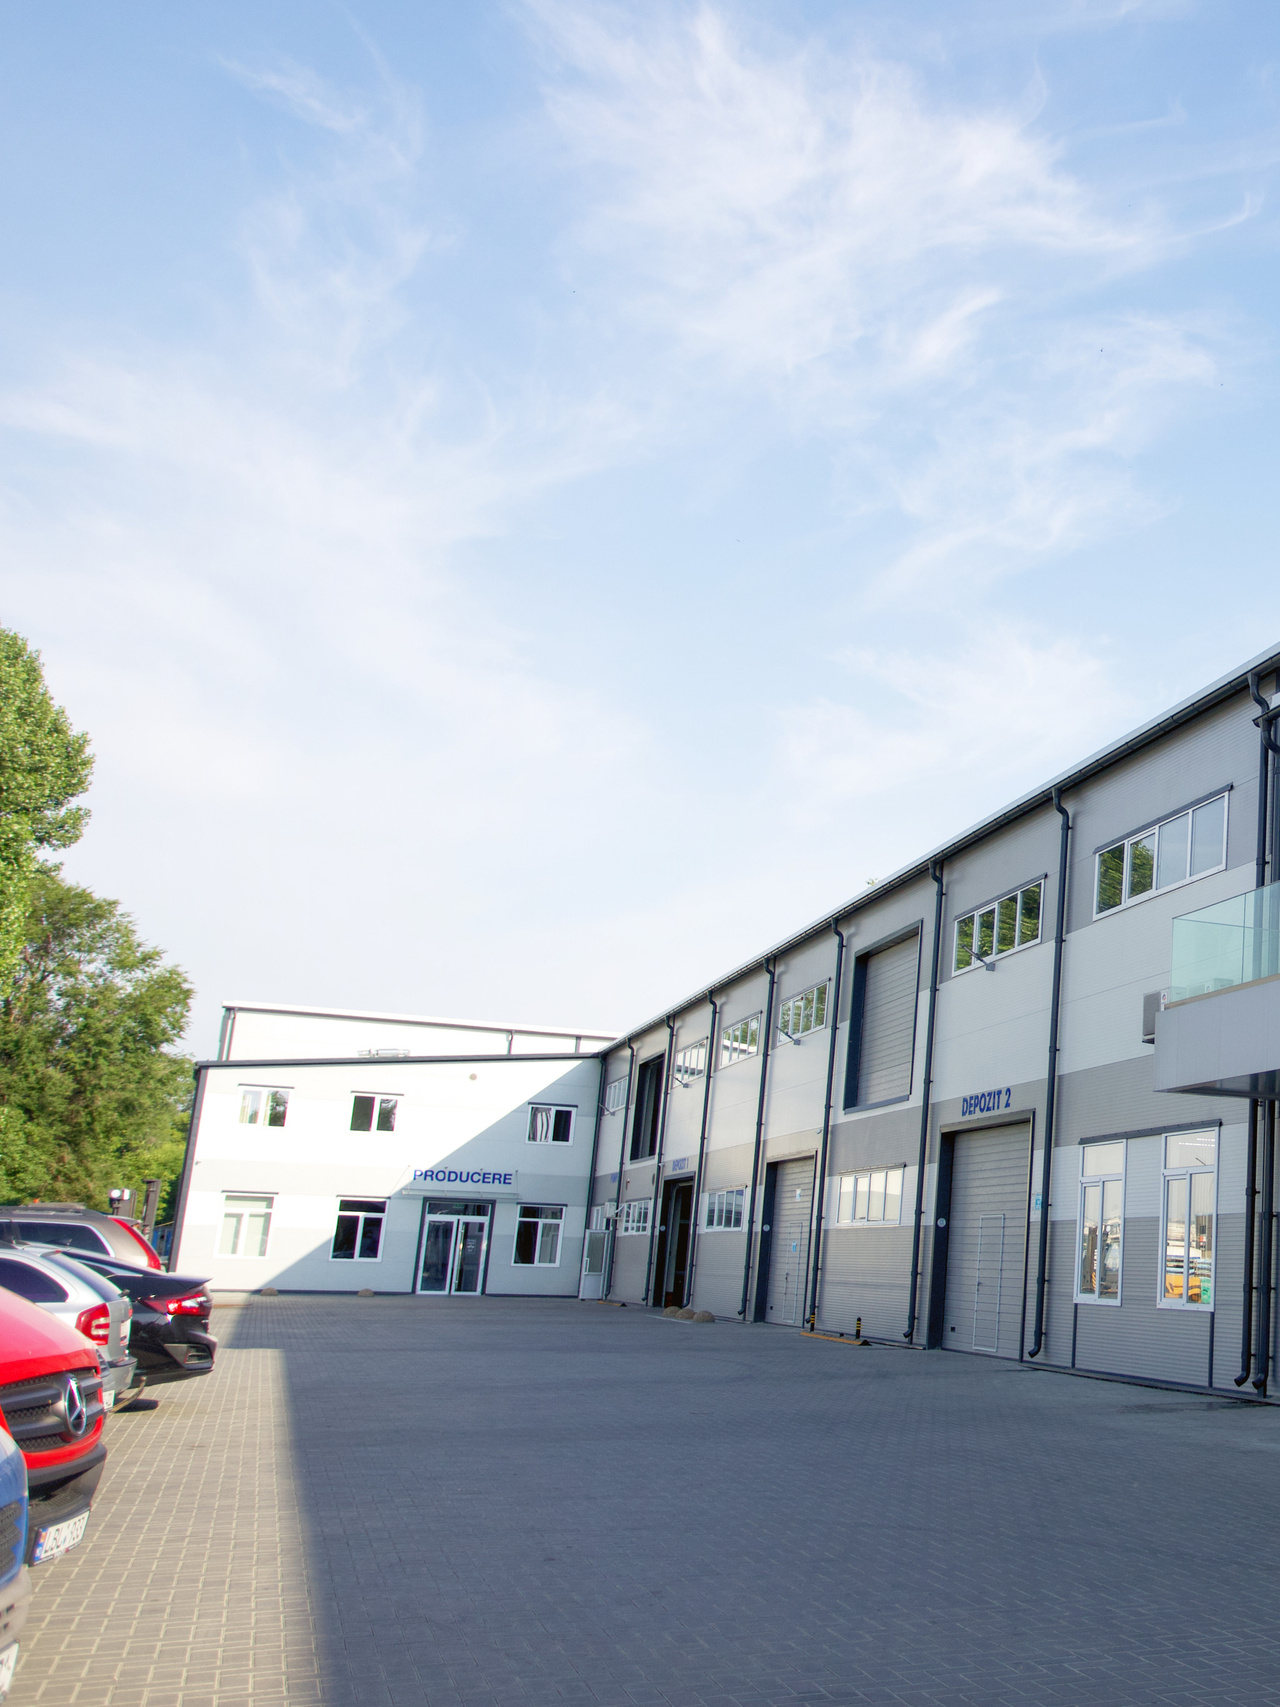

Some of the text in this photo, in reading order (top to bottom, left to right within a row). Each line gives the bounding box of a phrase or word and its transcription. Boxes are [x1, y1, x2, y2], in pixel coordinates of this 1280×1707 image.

[962, 1087, 1011, 1117] DEPOZIT 2
[413, 1169, 513, 1185] PRODUCERE
